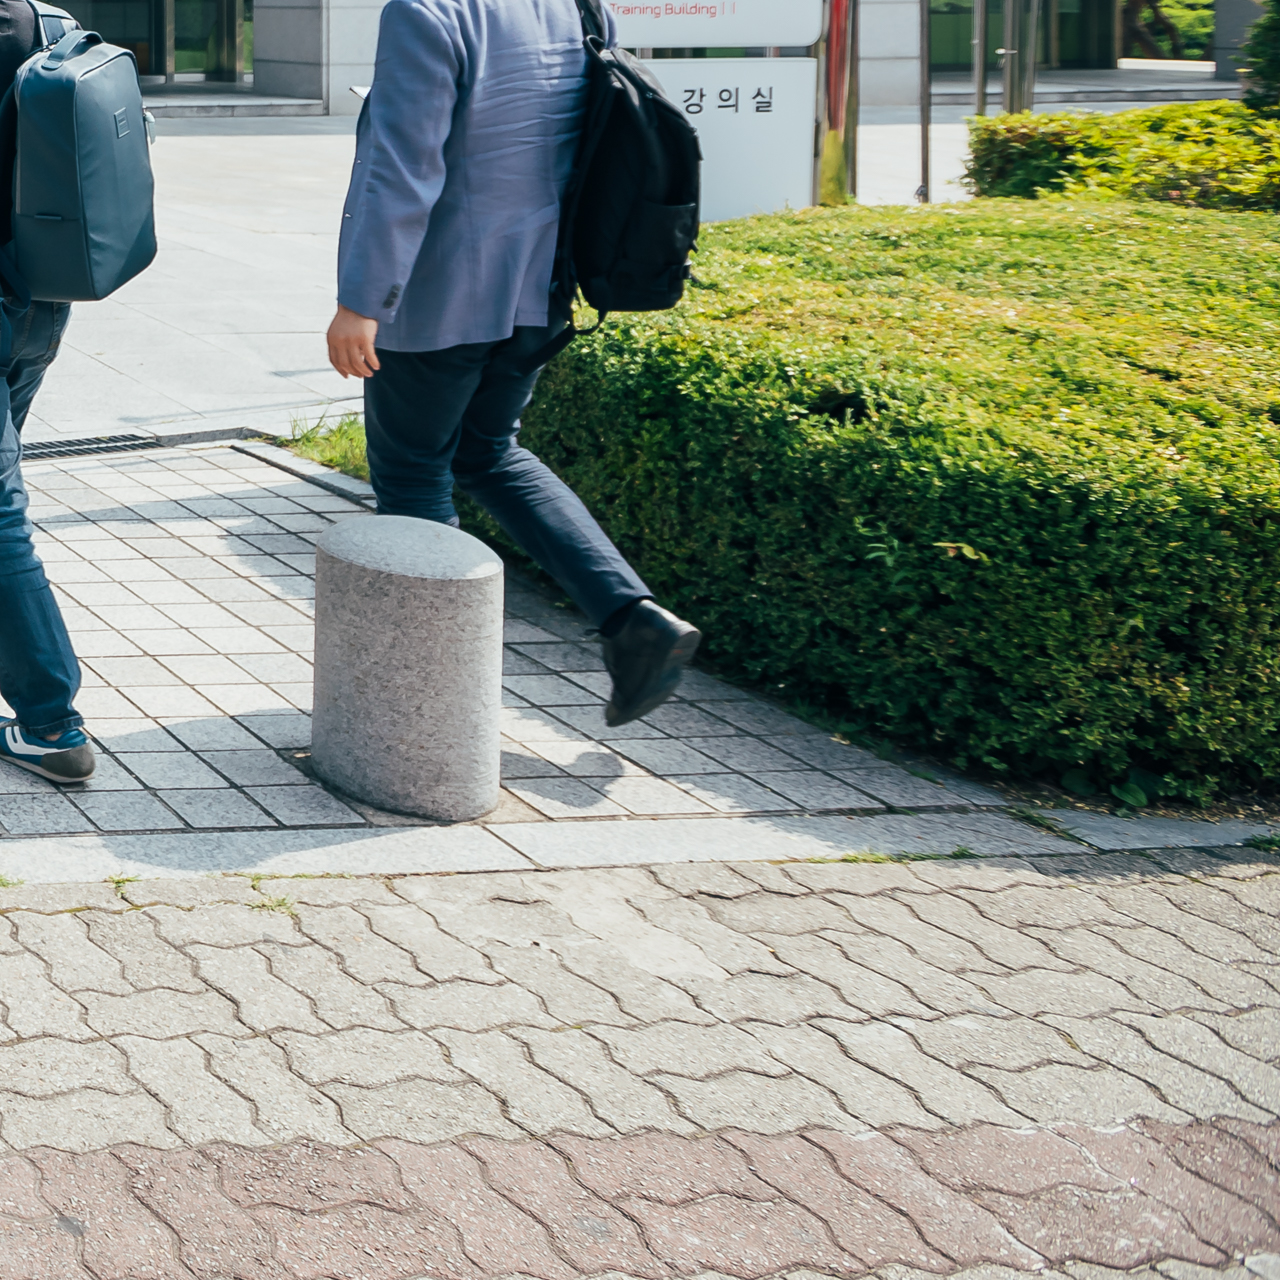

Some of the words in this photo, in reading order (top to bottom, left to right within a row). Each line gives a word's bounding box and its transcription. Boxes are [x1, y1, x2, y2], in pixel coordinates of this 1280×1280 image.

[609, 1, 661, 19] Training
[664, 1, 717, 18] Building
[682, 86, 773, 114] 강의실
